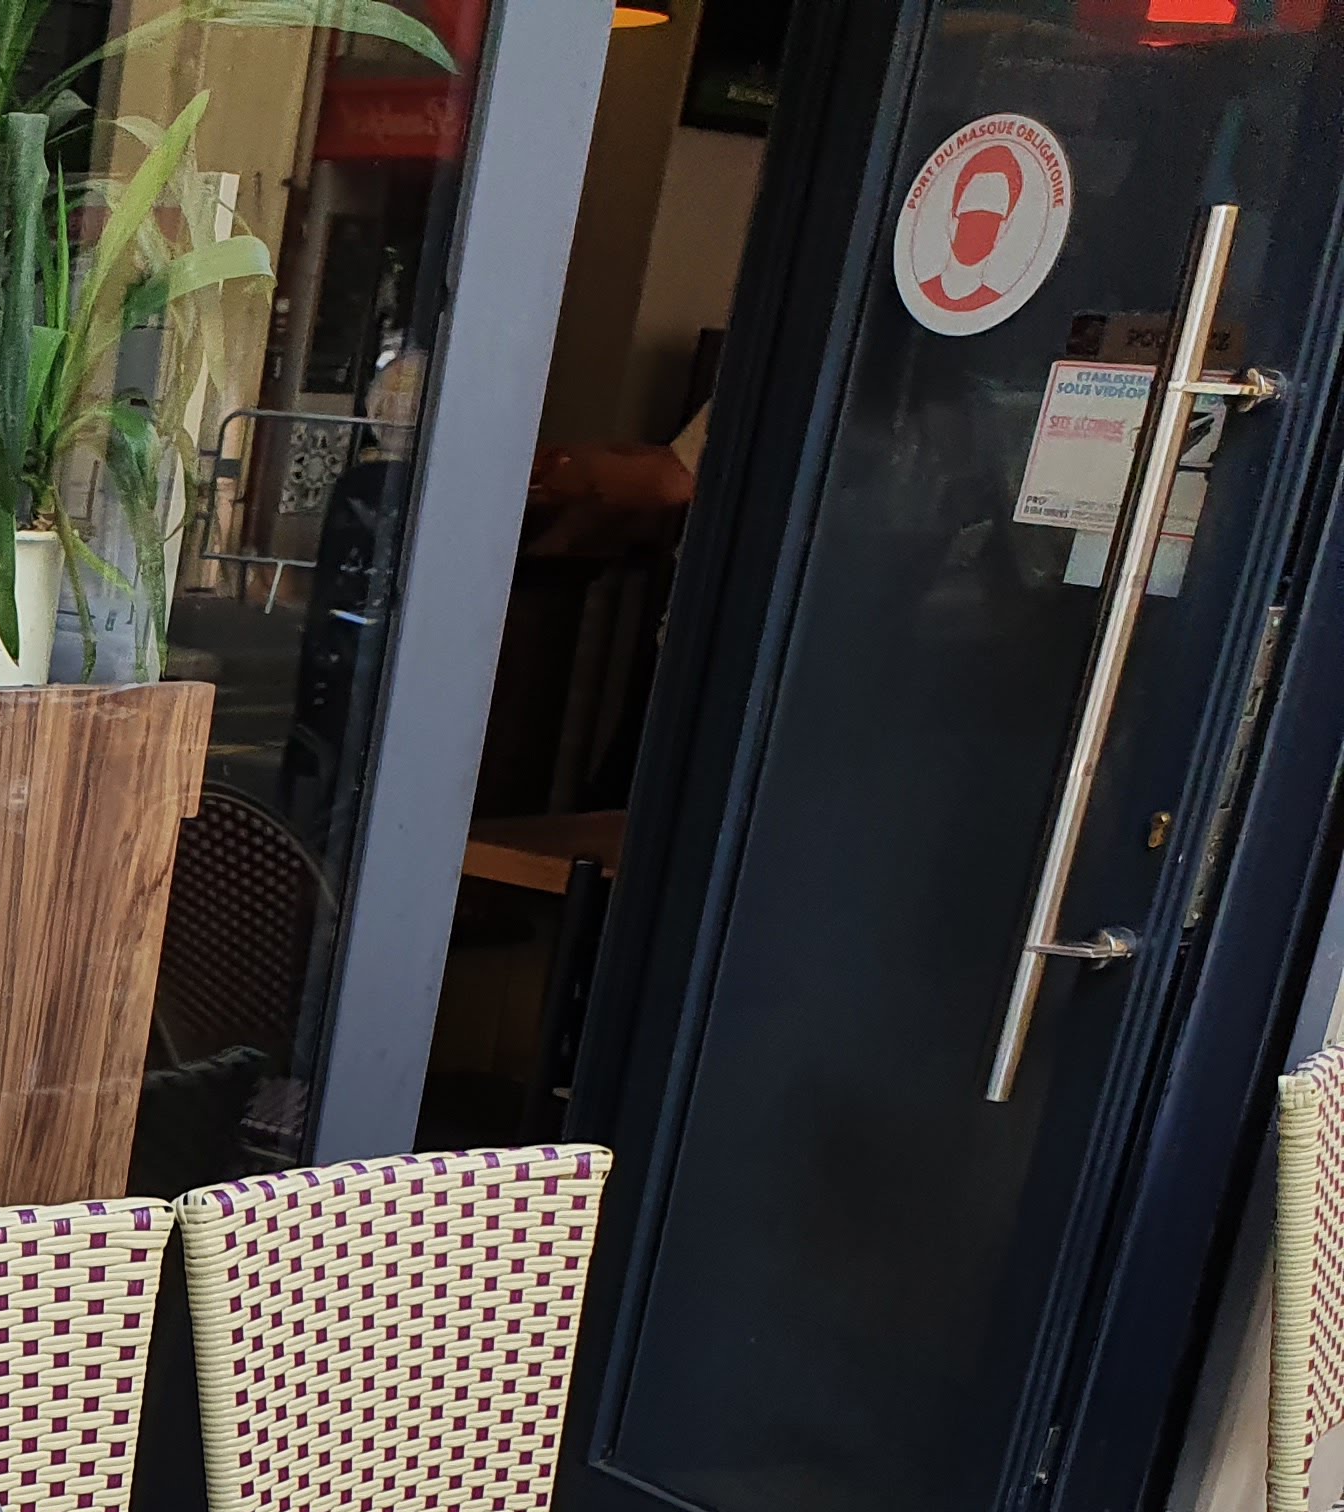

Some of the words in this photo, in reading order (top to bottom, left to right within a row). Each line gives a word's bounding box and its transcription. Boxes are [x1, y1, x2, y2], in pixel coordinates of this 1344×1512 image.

[934, 144, 954, 168] DU
[957, 121, 1014, 149] MASQUE
[1016, 124, 1064, 209] OBLIGATOIRE
